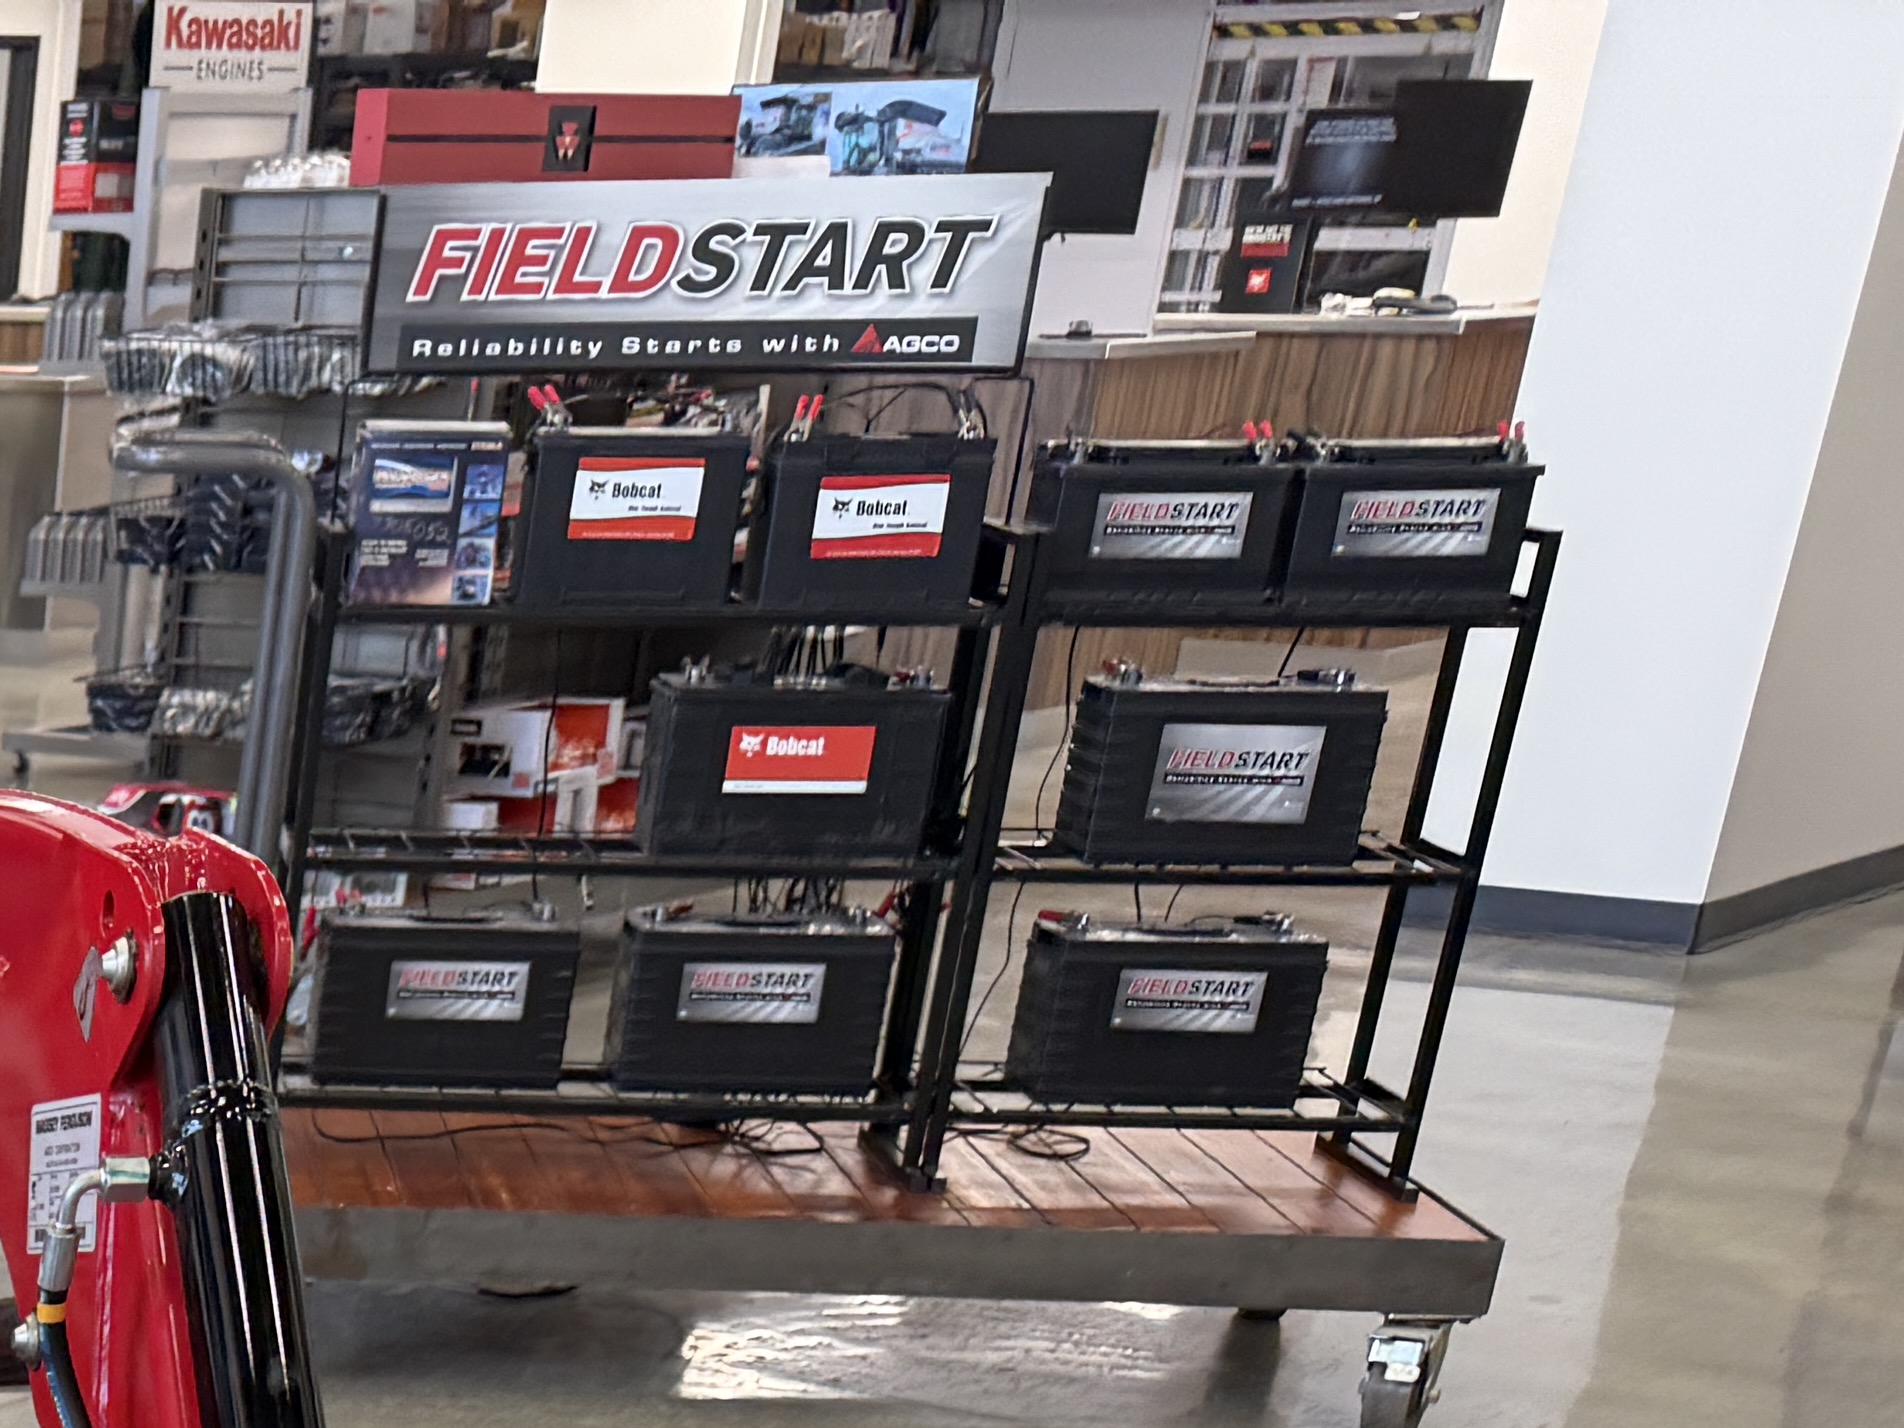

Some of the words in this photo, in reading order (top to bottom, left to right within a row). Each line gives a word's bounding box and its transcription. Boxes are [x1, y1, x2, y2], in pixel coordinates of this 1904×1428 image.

[164, 6, 303, 51] Kawasaki
[196, 60, 264, 81] ENGINES
[406, 218, 1000, 301] FIELDSTART
[411, 337, 603, 359] Reliability
[621, 336, 742, 355] Starts
[762, 334, 840, 354] with
[882, 333, 960, 354] AGCO
[611, 482, 663, 499] Bobcat
[855, 499, 908, 516] Bobcat
[1106, 501, 1241, 520] FIELDSTART
[1351, 499, 1487, 519] FIELDSTART
[765, 735, 825, 758] Bobcat
[1164, 748, 1310, 770] FIELDSTART
[1127, 978, 1255, 997] FIELDSTART
